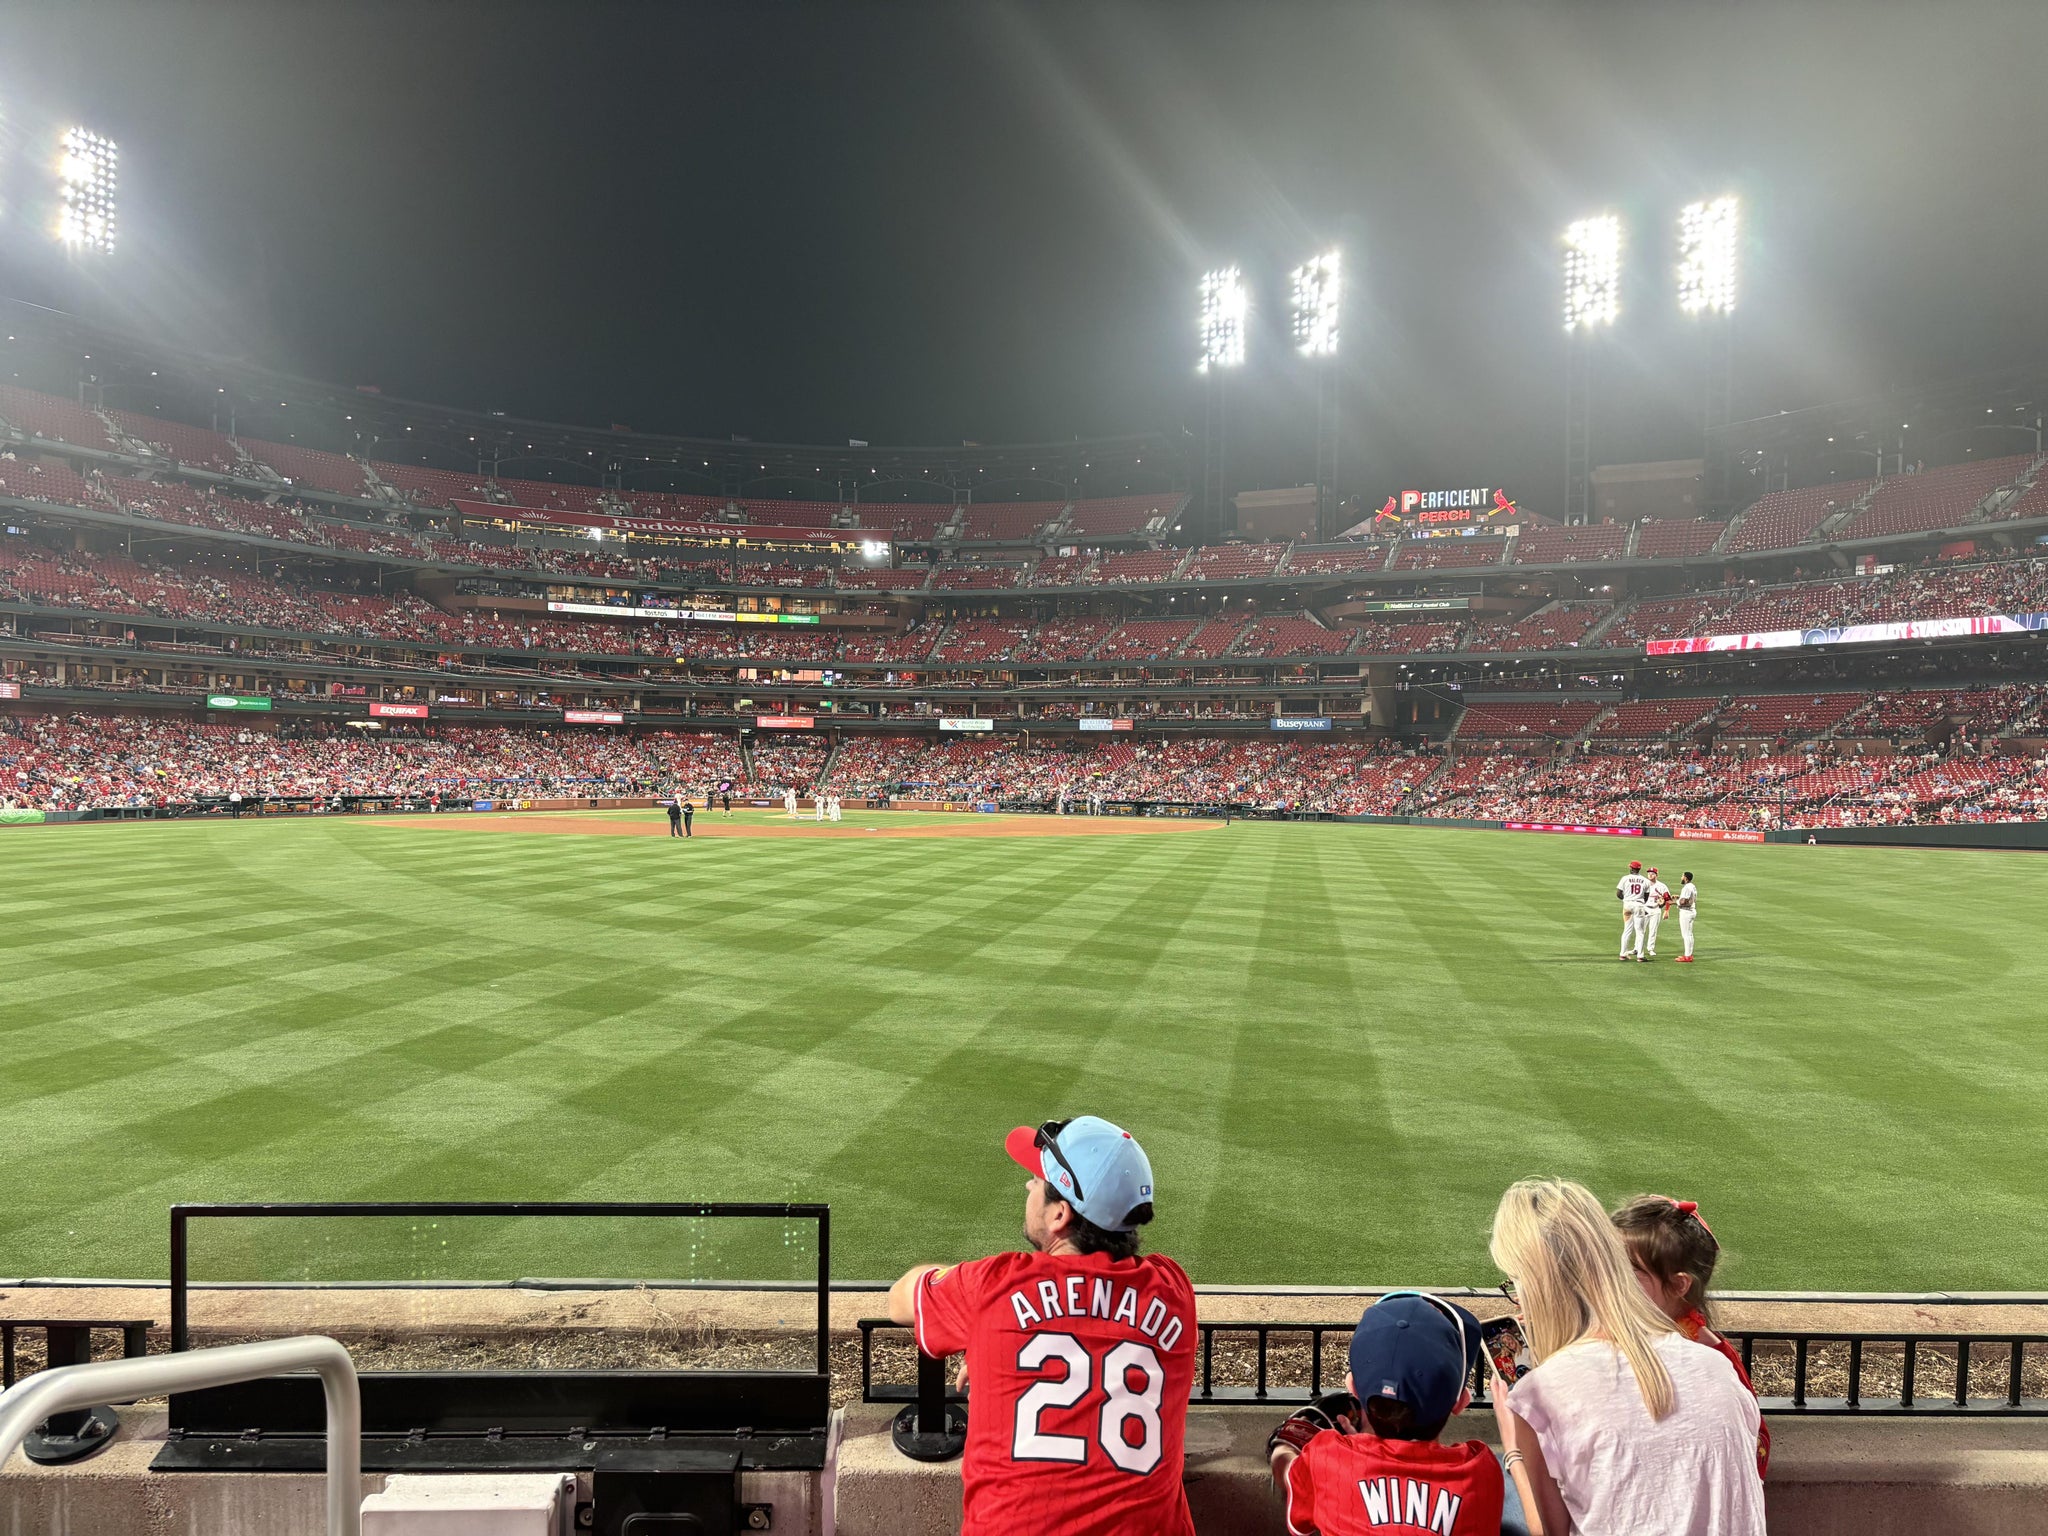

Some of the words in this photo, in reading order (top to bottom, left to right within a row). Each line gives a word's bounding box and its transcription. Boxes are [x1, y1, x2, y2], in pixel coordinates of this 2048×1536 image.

[1401, 488, 1489, 513] PERFICIENT
[1419, 509, 1471, 523] PERCH
[612, 518, 747, 536] Budweiser
[380, 705, 418, 716] EQUIFAX
[1630, 883, 1642, 895] 18
[1010, 1275, 1184, 1353] ARENADO
[1011, 1330, 1165, 1477] 28
[1357, 1477, 1462, 1536] WINN
